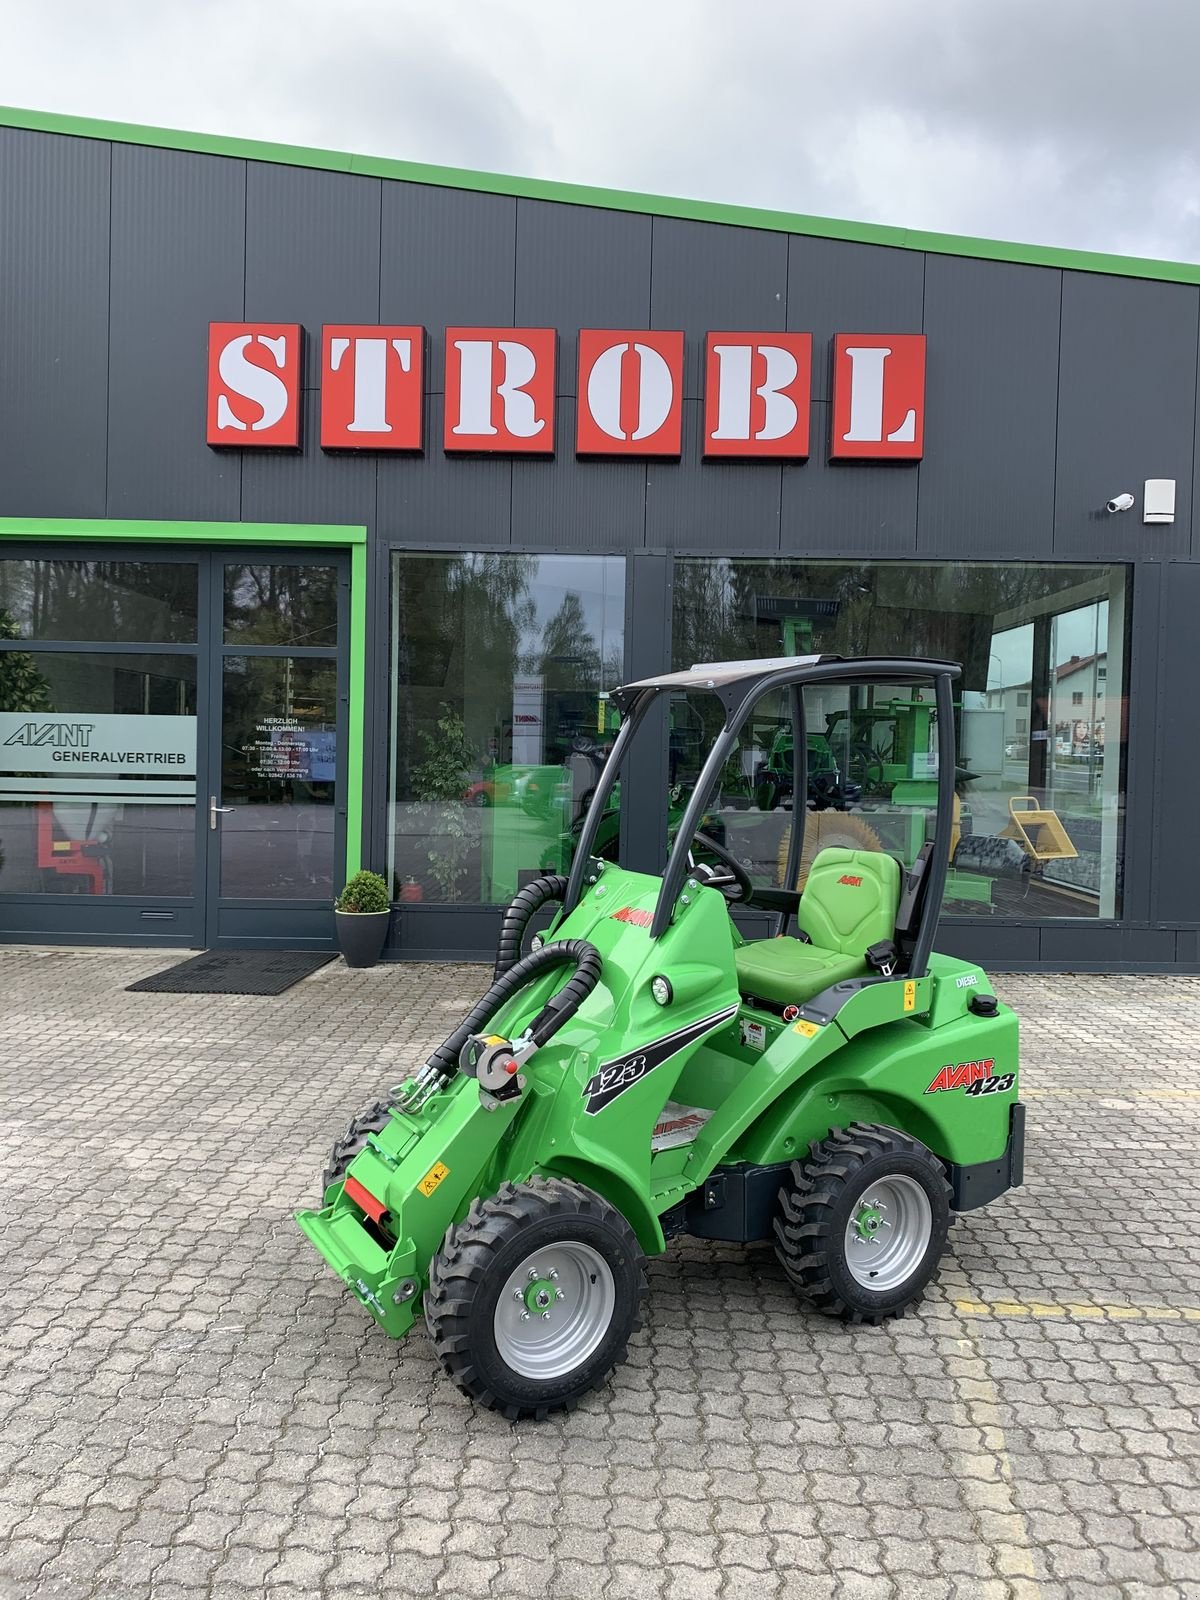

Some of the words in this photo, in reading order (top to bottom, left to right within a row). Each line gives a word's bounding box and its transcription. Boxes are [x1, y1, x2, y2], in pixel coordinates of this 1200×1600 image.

[217, 334, 916, 442] STROBL
[3, 723, 93, 747] AVANT
[52, 751, 186, 764] GENERALVERTRIEB
[956, 975, 979, 988] DIESEL
[581, 1055, 646, 1098] 423
[923, 1057, 995, 1095] AVANT
[965, 1072, 1017, 1098] 423
